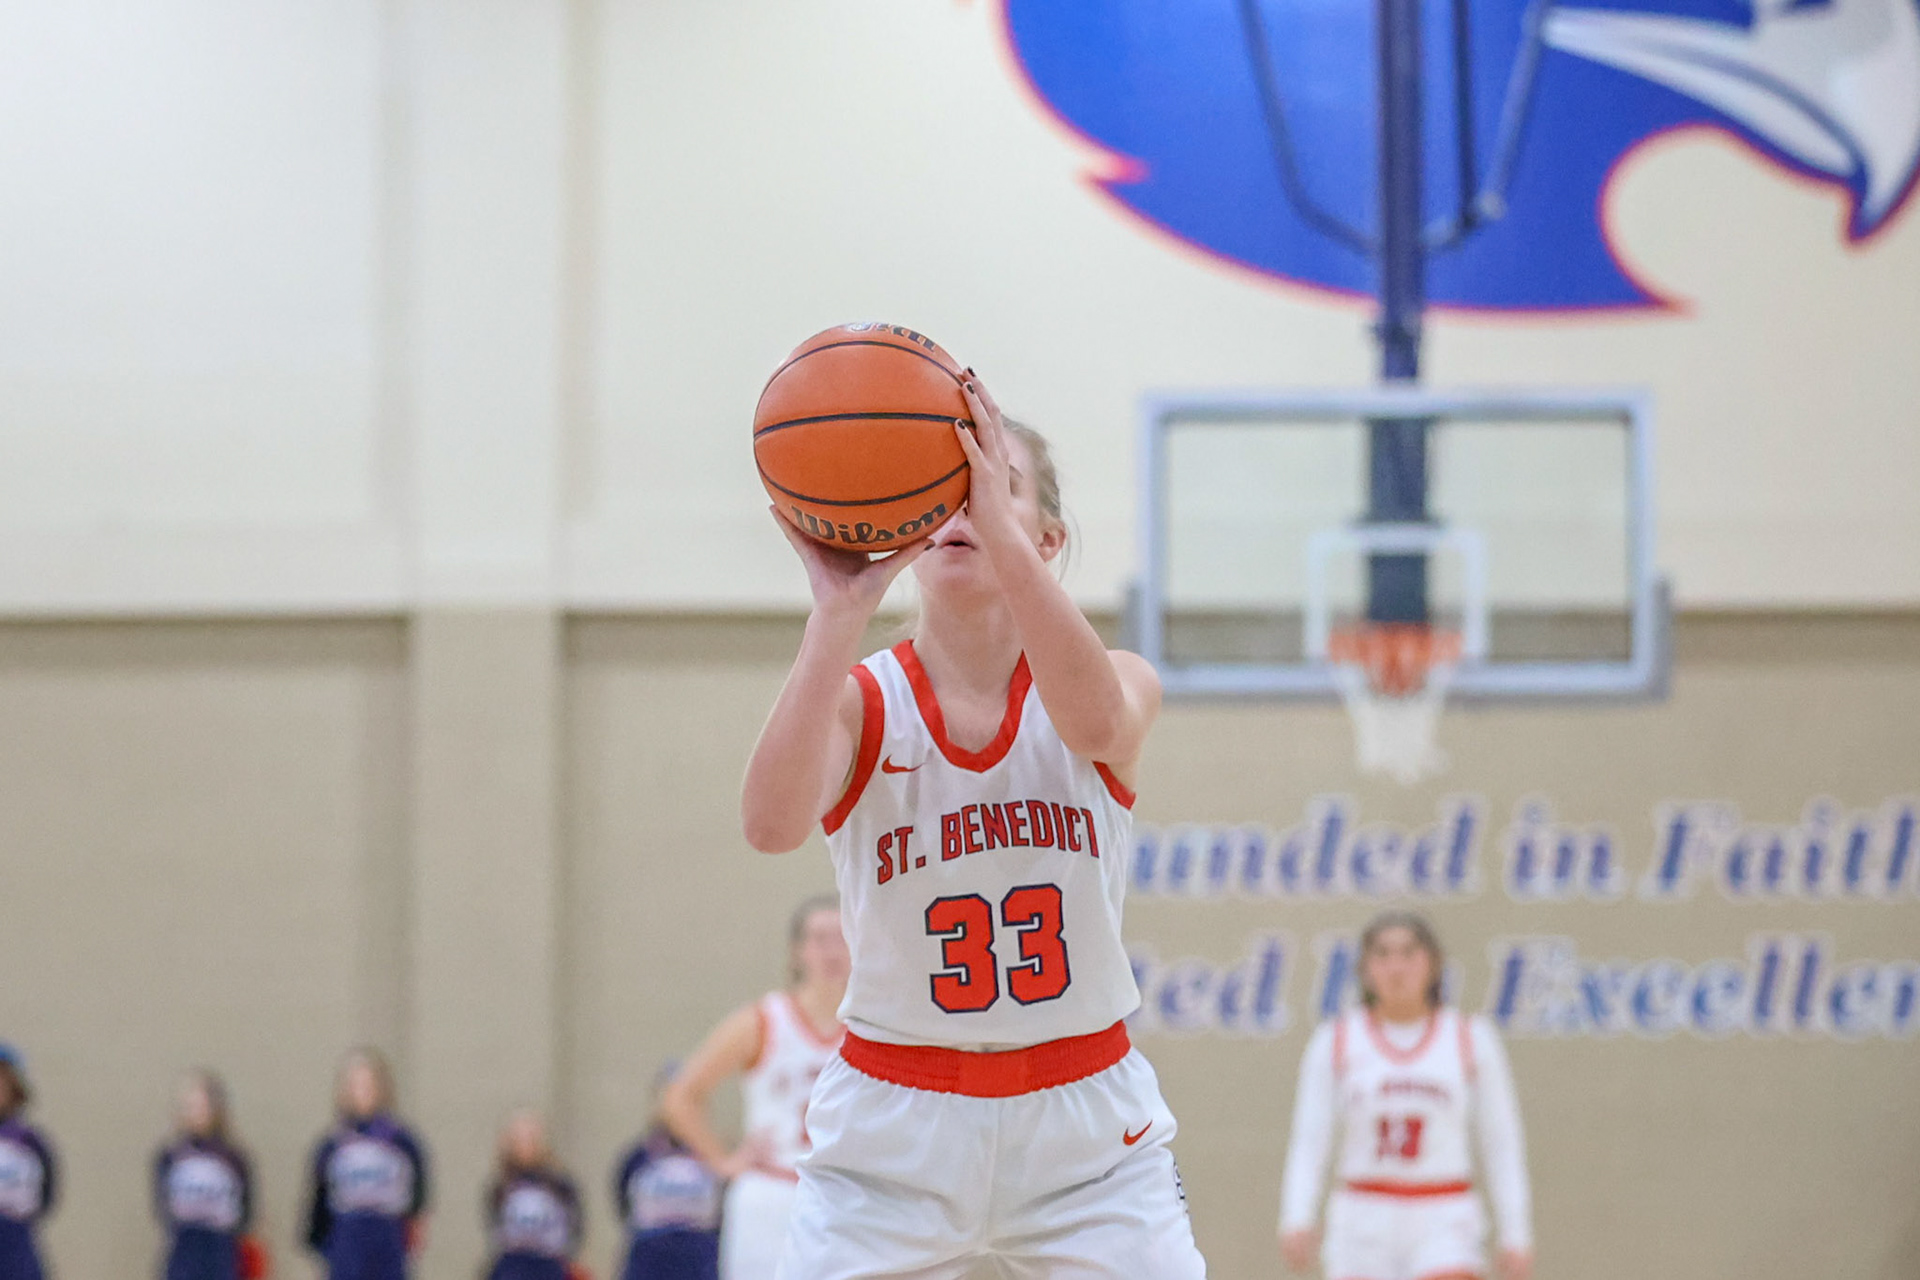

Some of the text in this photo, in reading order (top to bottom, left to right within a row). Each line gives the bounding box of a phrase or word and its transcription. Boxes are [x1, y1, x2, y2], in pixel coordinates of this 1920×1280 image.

[790, 502, 948, 545] Wilson
[876, 799, 1100, 886] ST. BENEDICT
[1512, 800, 1622, 892] in
[924, 882, 1072, 1014] 33
